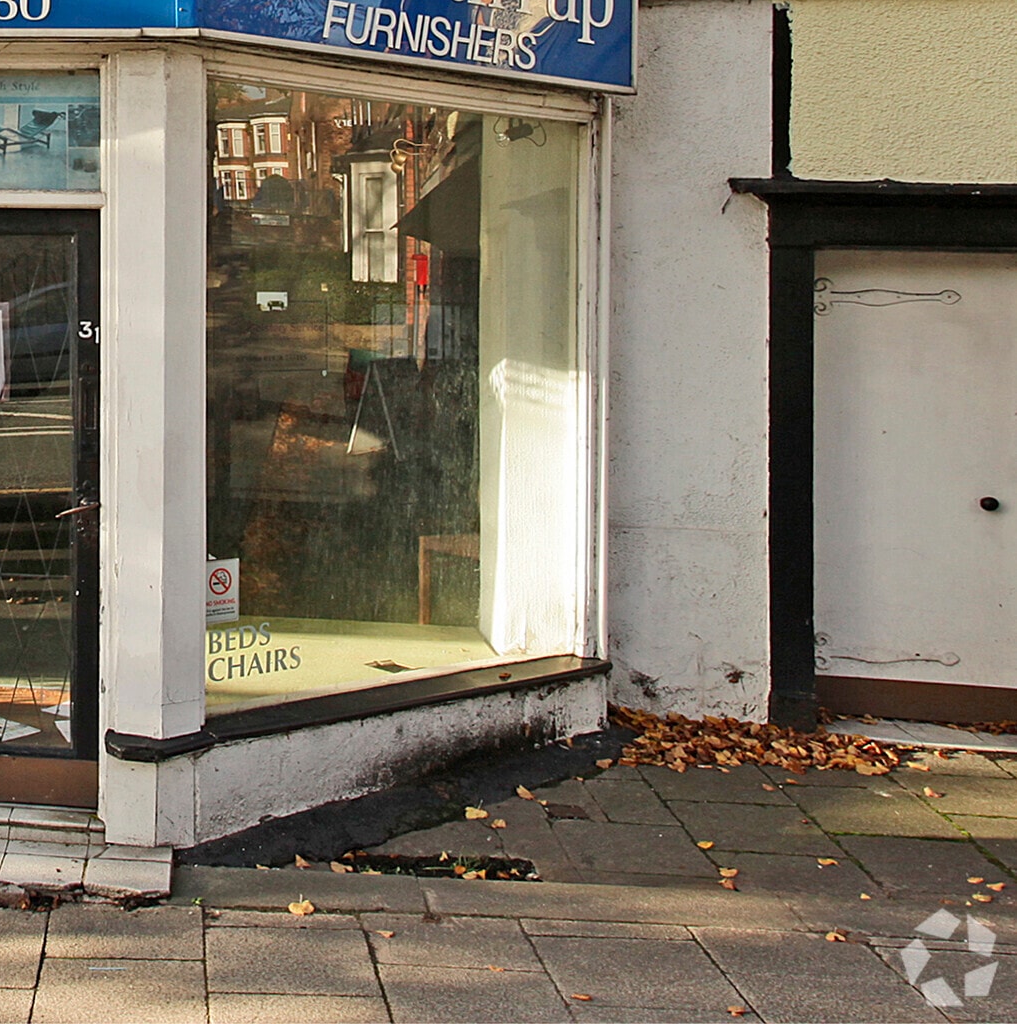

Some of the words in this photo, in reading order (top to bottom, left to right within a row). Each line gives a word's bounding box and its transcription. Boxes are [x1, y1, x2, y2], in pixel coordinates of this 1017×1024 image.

[322, 0, 537, 70] FURNISHERS
[12, 80, 41, 95] Style
[208, 622, 271, 655] BEDS
[208, 646, 301, 682] CHAIRS
